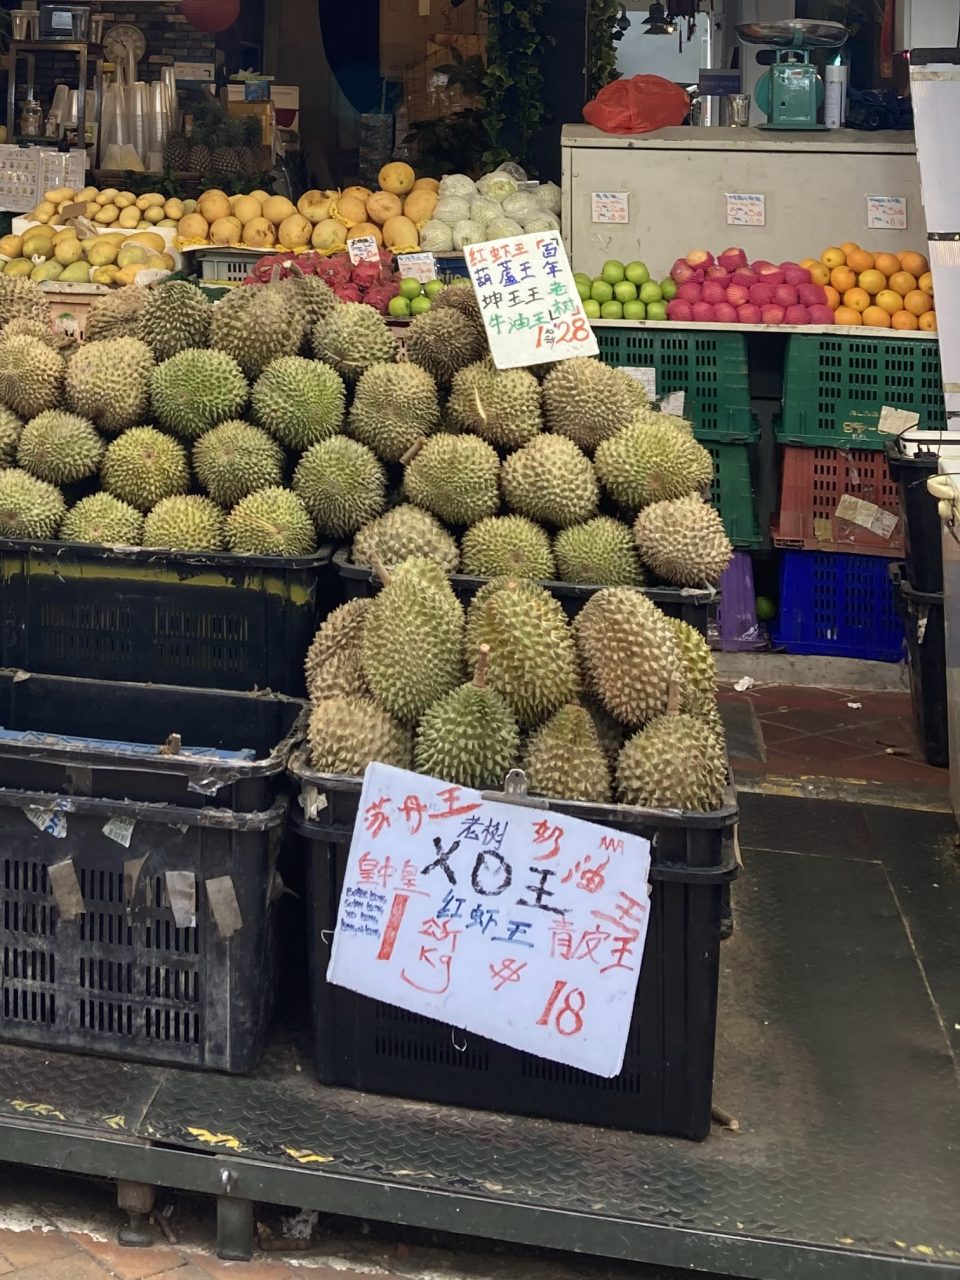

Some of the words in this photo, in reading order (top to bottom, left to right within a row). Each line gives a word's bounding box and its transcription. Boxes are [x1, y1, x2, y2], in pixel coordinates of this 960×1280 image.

[469, 242, 529, 267] 红虾王
[488, 311, 551, 335] 牛油王
[364, 786, 483, 838] 苏丹王
[356, 851, 431, 898] 皇中皇
[436, 889, 534, 949] 红虾王
[547, 917, 637, 975] 青皮王
